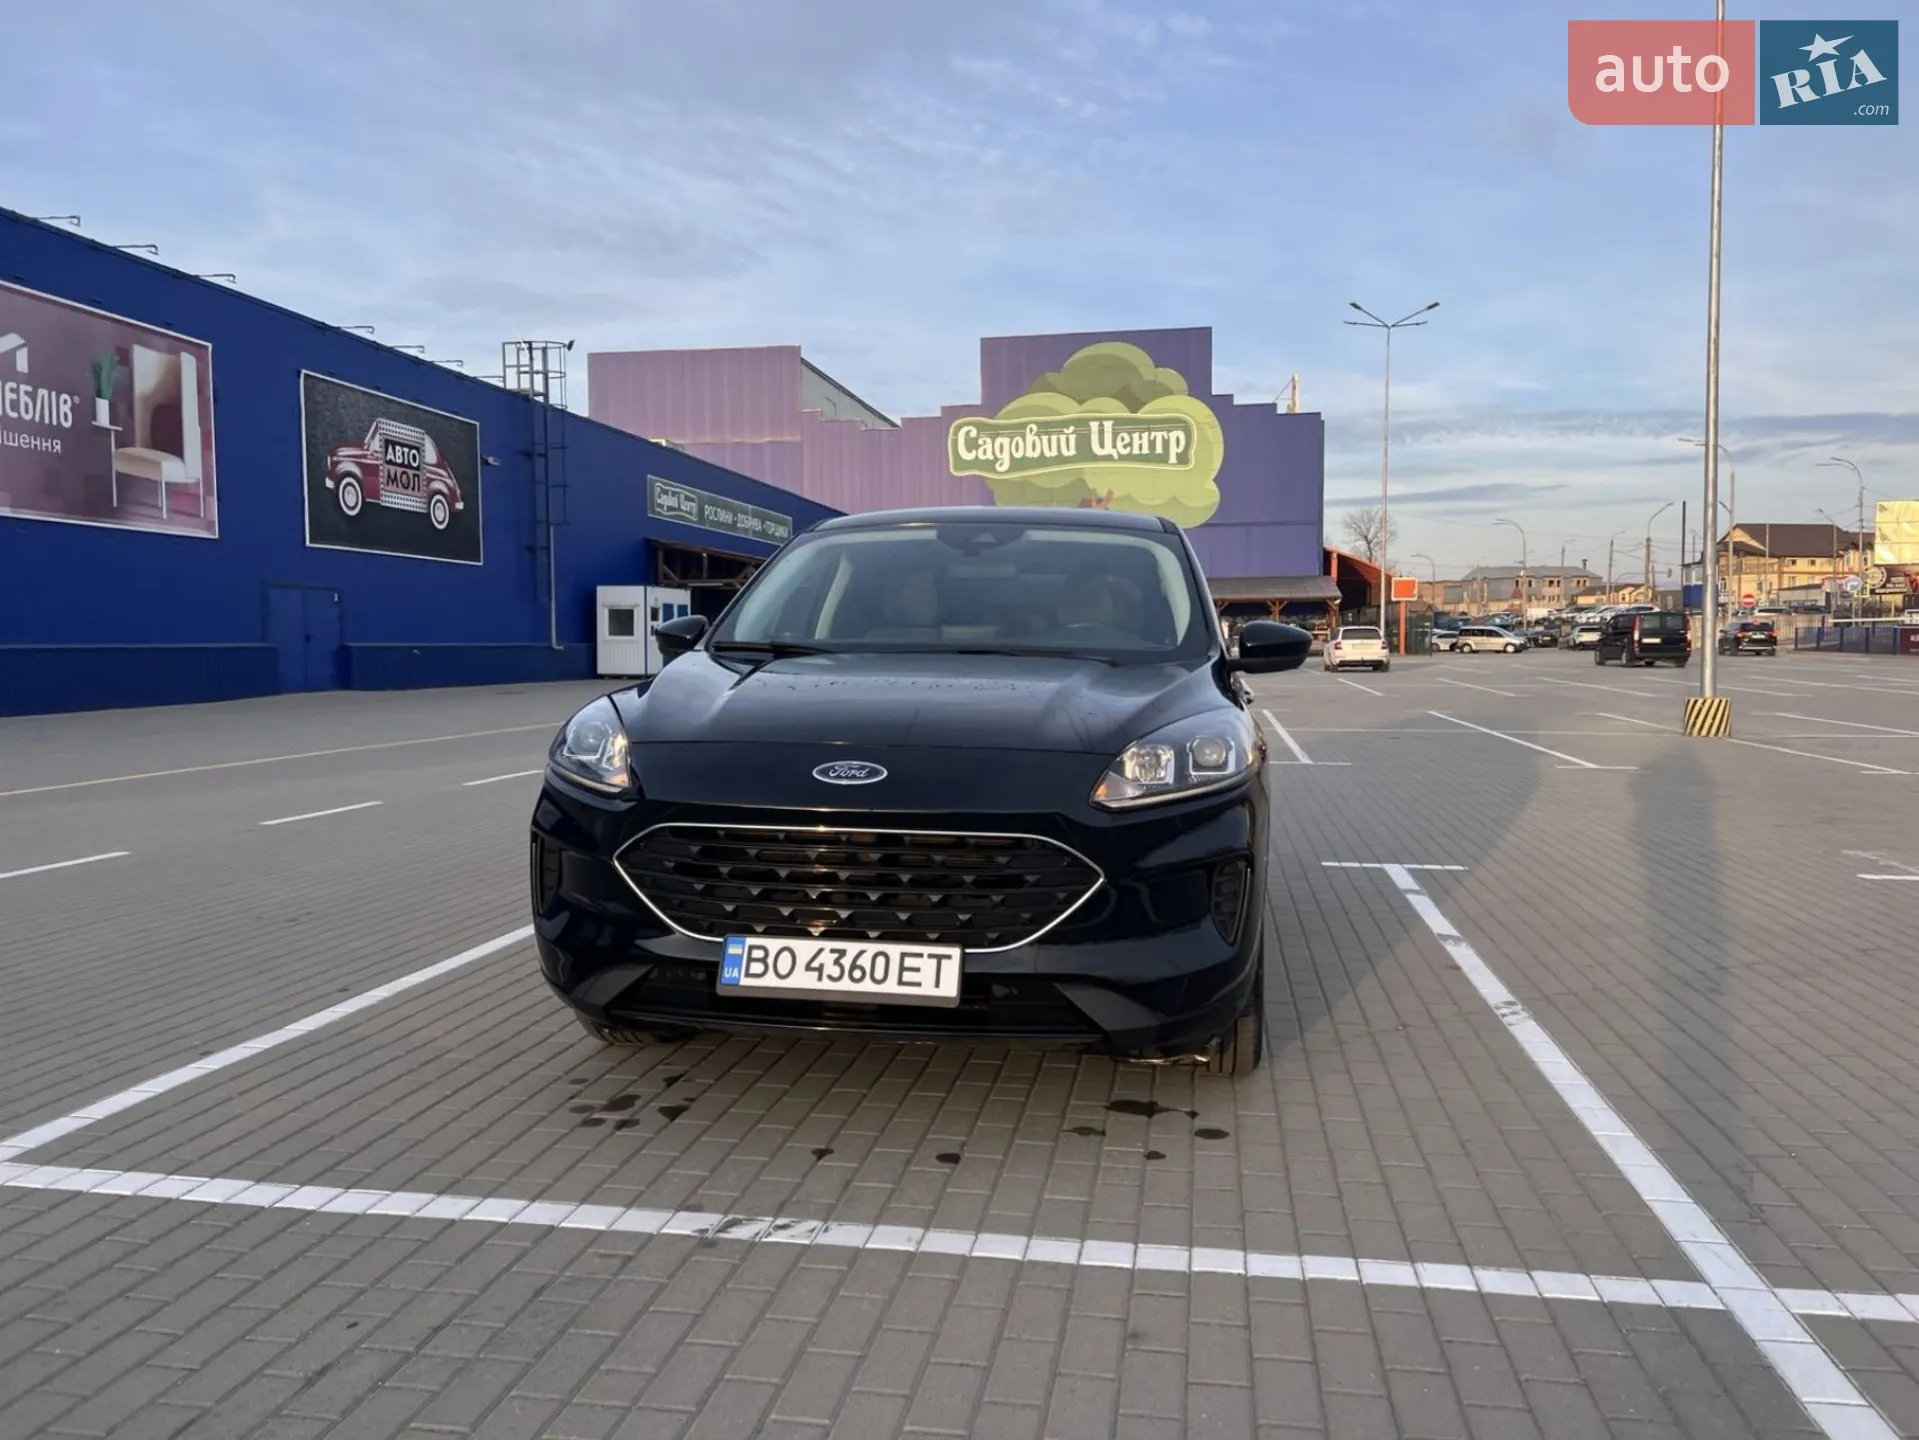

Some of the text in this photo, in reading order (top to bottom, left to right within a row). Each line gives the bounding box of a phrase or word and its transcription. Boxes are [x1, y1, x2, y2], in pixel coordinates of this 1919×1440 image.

[0, 379, 73, 429] ЕБЛІВ
[386, 443, 420, 468] АВТО
[956, 420, 1186, 473] Садовий Центр
[386, 470, 421, 492] МОЛ
[829, 764, 870, 777] Ford
[723, 967, 739, 979] UA
[744, 944, 953, 989] BO 4360 ET
